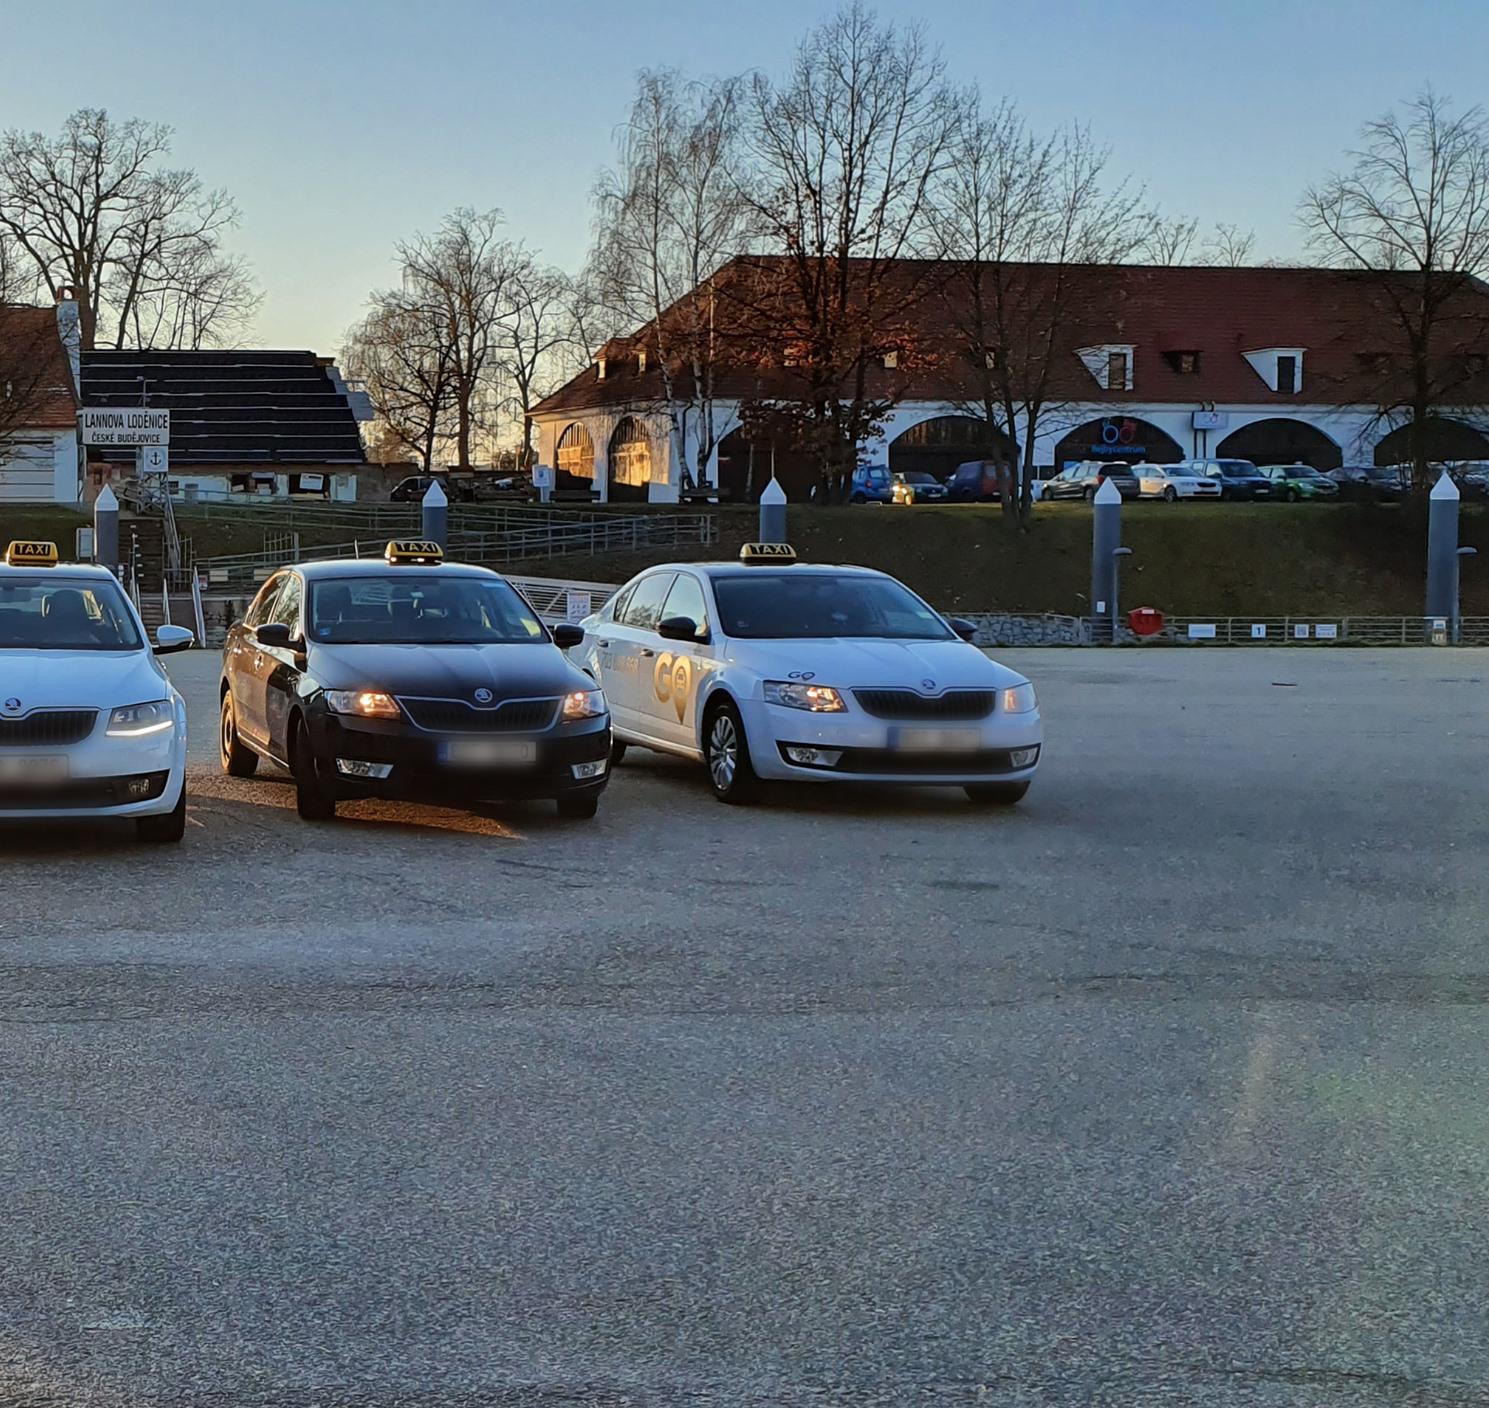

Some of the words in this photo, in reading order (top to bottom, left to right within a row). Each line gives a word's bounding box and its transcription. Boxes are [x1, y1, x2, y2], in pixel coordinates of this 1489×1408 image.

[85, 413, 124, 428] LANNOVA
[127, 411, 168, 429] LODĚNICE
[92, 432, 115, 443] ČESKÉ
[117, 432, 160, 443] BUDĚJOVICE
[17, 543, 49, 555] TAXI
[396, 542, 437, 552] TAXI
[751, 544, 789, 554] TAXI
